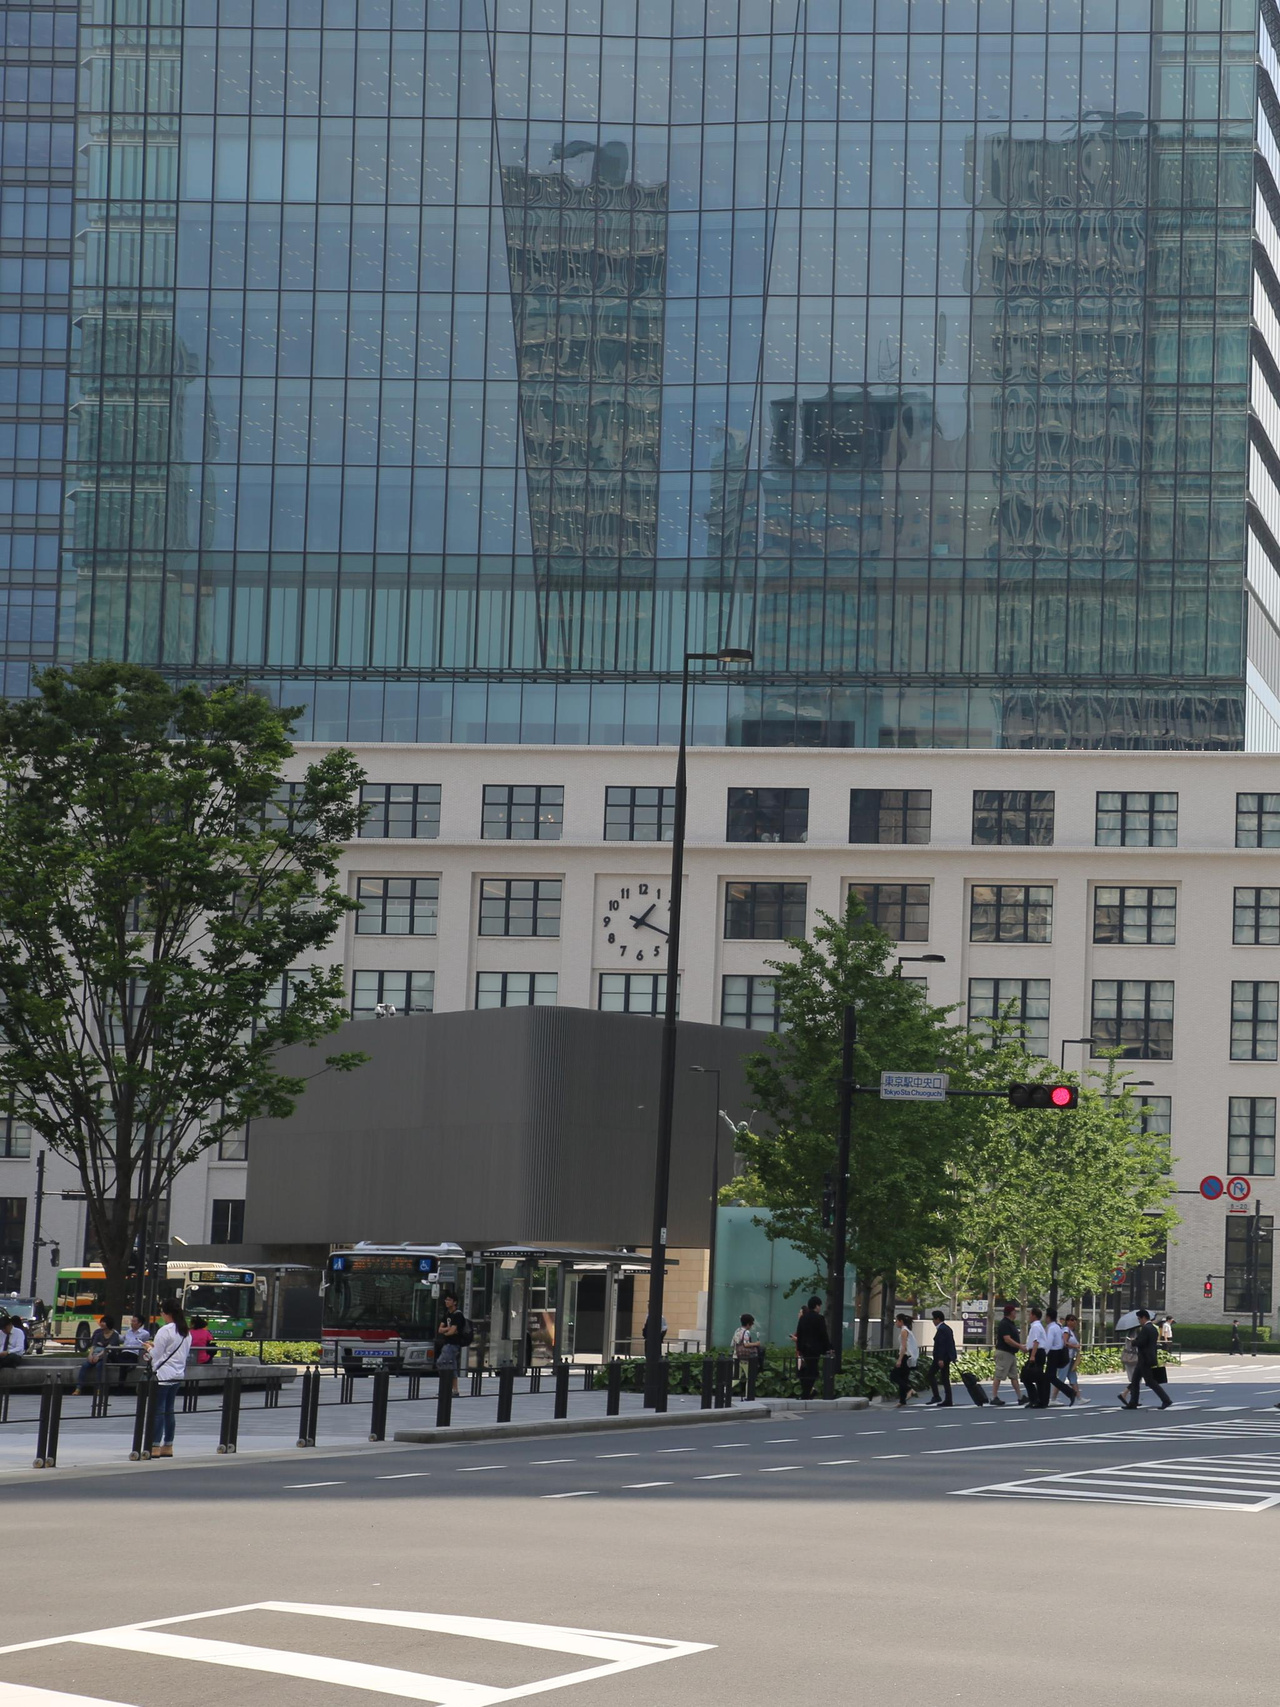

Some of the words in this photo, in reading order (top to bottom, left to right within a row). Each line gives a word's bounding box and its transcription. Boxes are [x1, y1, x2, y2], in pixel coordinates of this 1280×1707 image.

[620, 888, 630, 899] 11
[638, 883, 649, 895] 12
[656, 888, 661, 900] 1
[608, 900, 620, 911] 10
[603, 916, 611, 927] 9
[607, 932, 616, 944] 8
[619, 945, 627, 957] 7
[636, 950, 644, 961] 6
[653, 945, 660, 957] 5
[885, 1076, 942, 1089] 東京駅中央口
[884, 1089, 900, 1097] Tokyo
[911, 1089, 943, 1098] Chuoguchi
